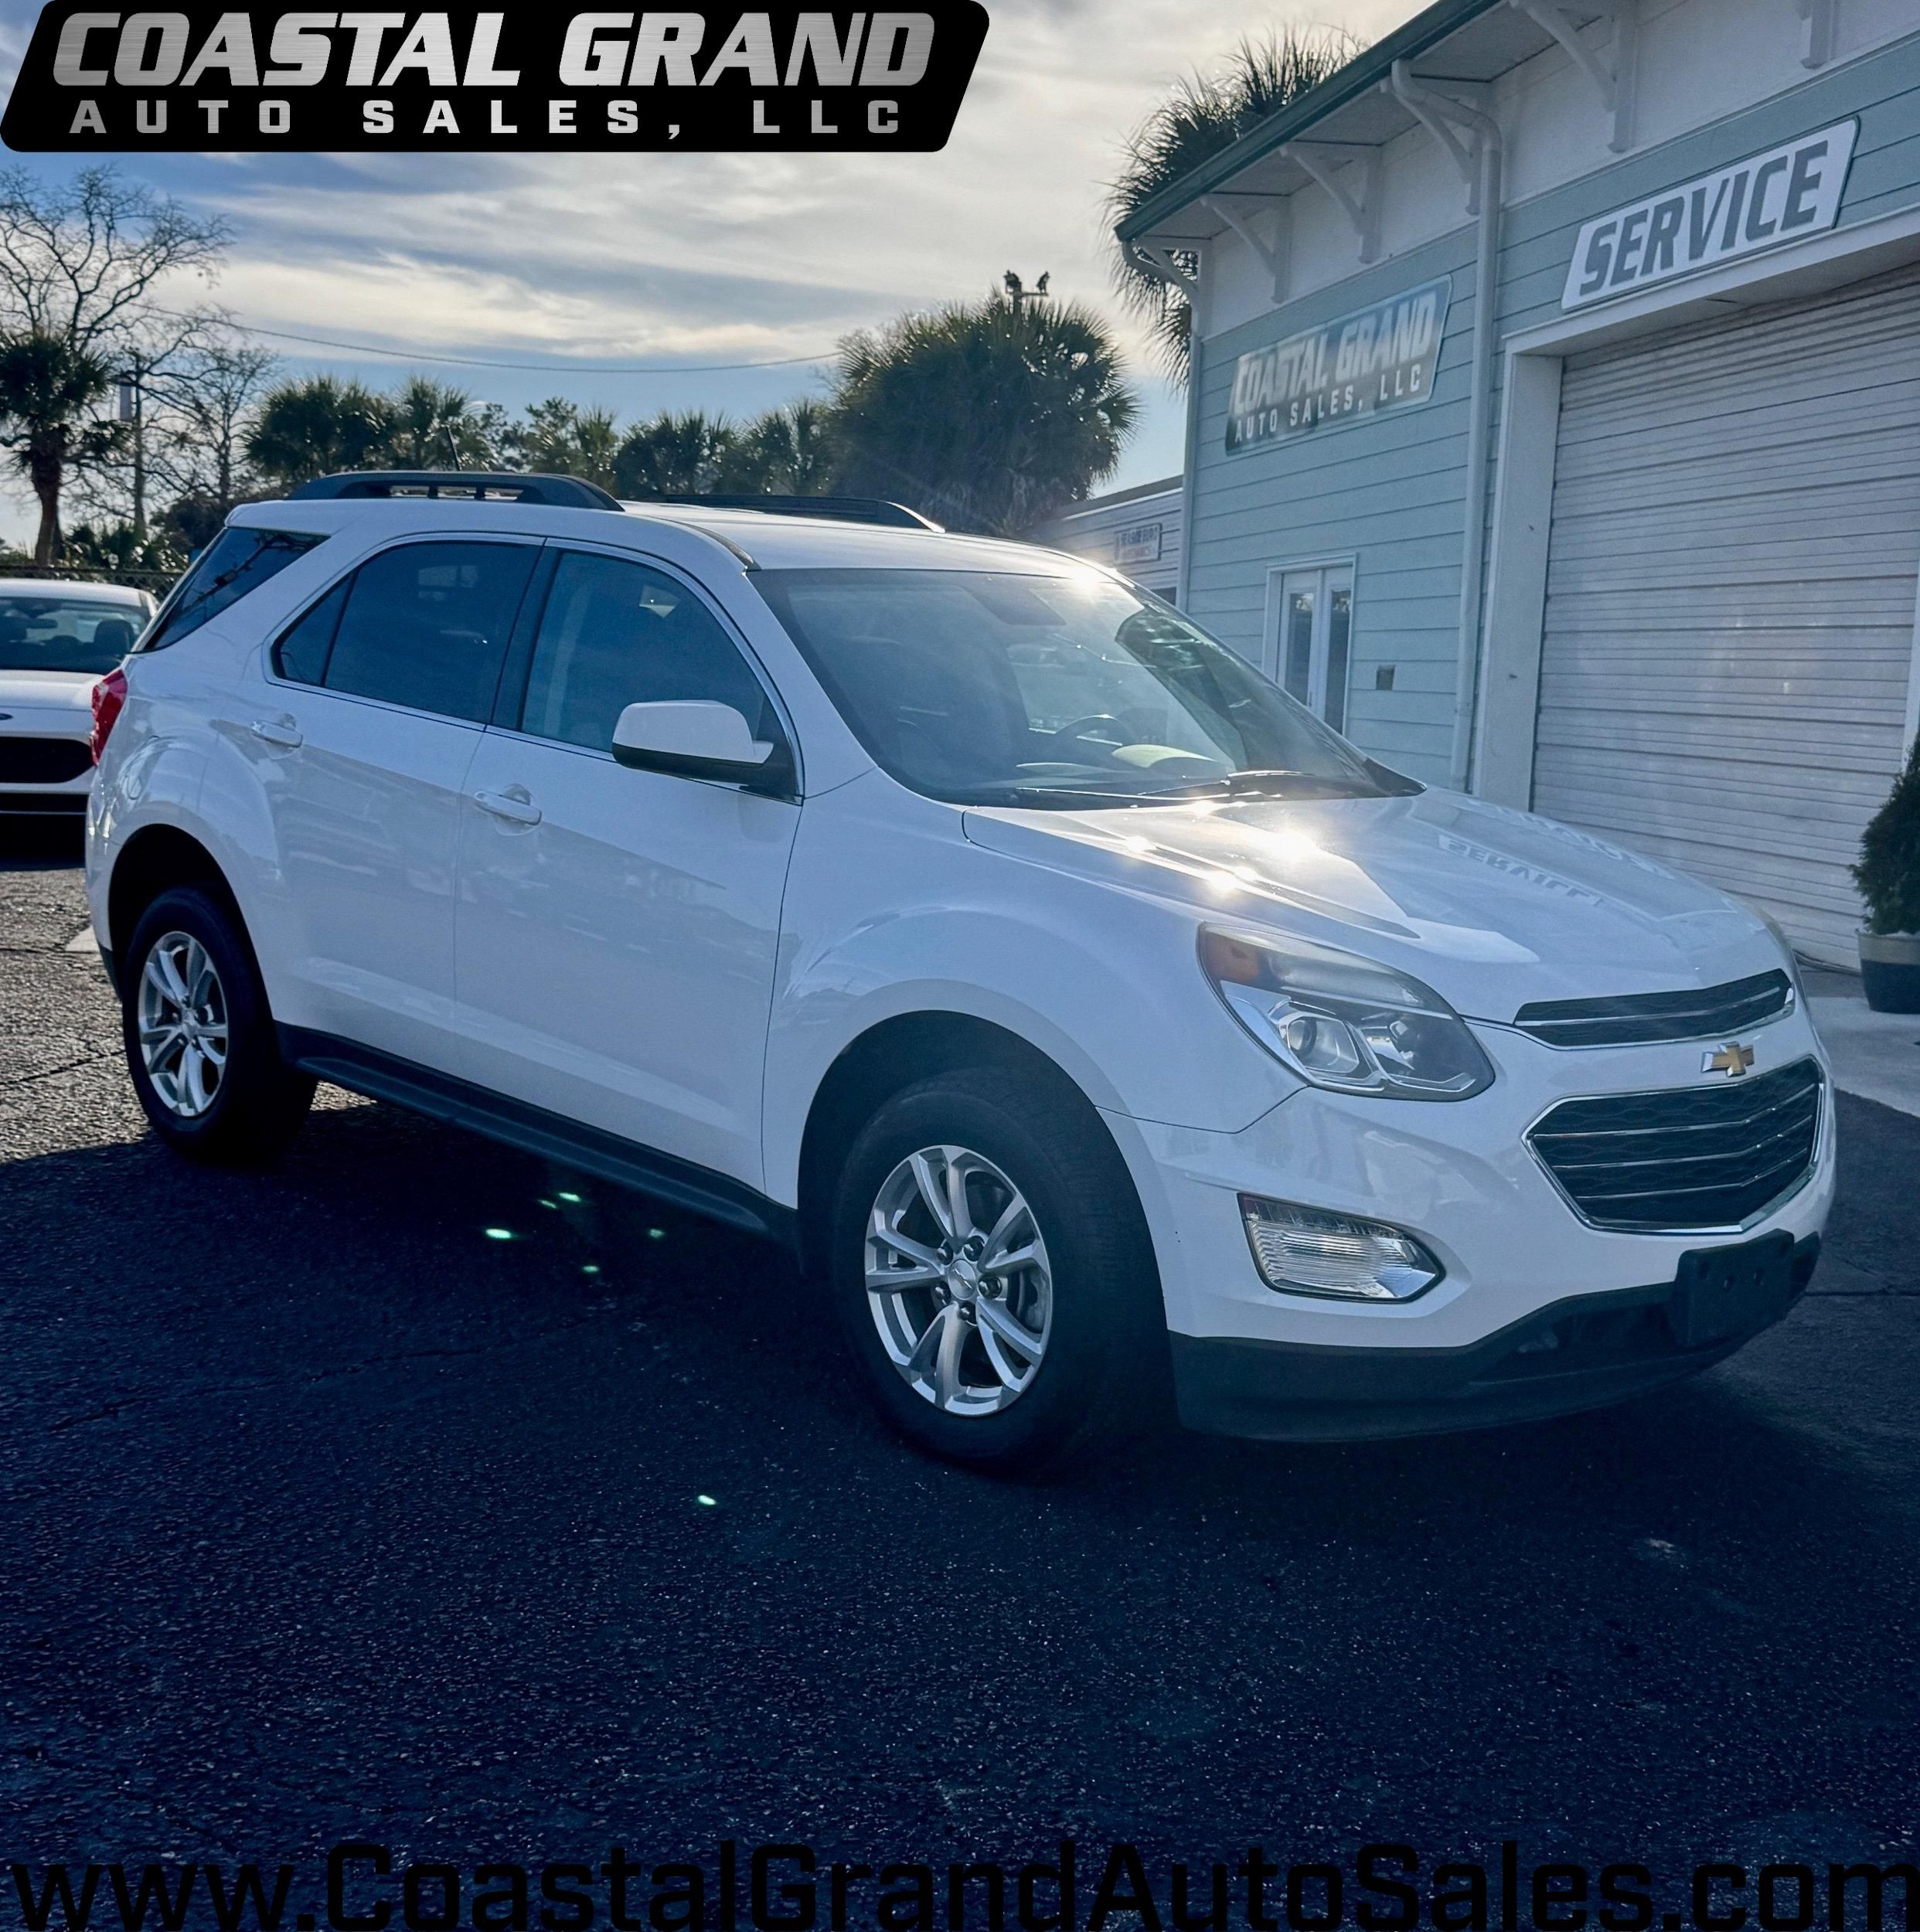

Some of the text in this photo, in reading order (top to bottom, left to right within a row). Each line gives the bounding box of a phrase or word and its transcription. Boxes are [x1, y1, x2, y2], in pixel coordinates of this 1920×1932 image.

[1579, 140, 1829, 297] SERVICE
[1234, 292, 1436, 416] COASTAL GRAND
[1235, 364, 1421, 443] AUTO SALES, LLC
